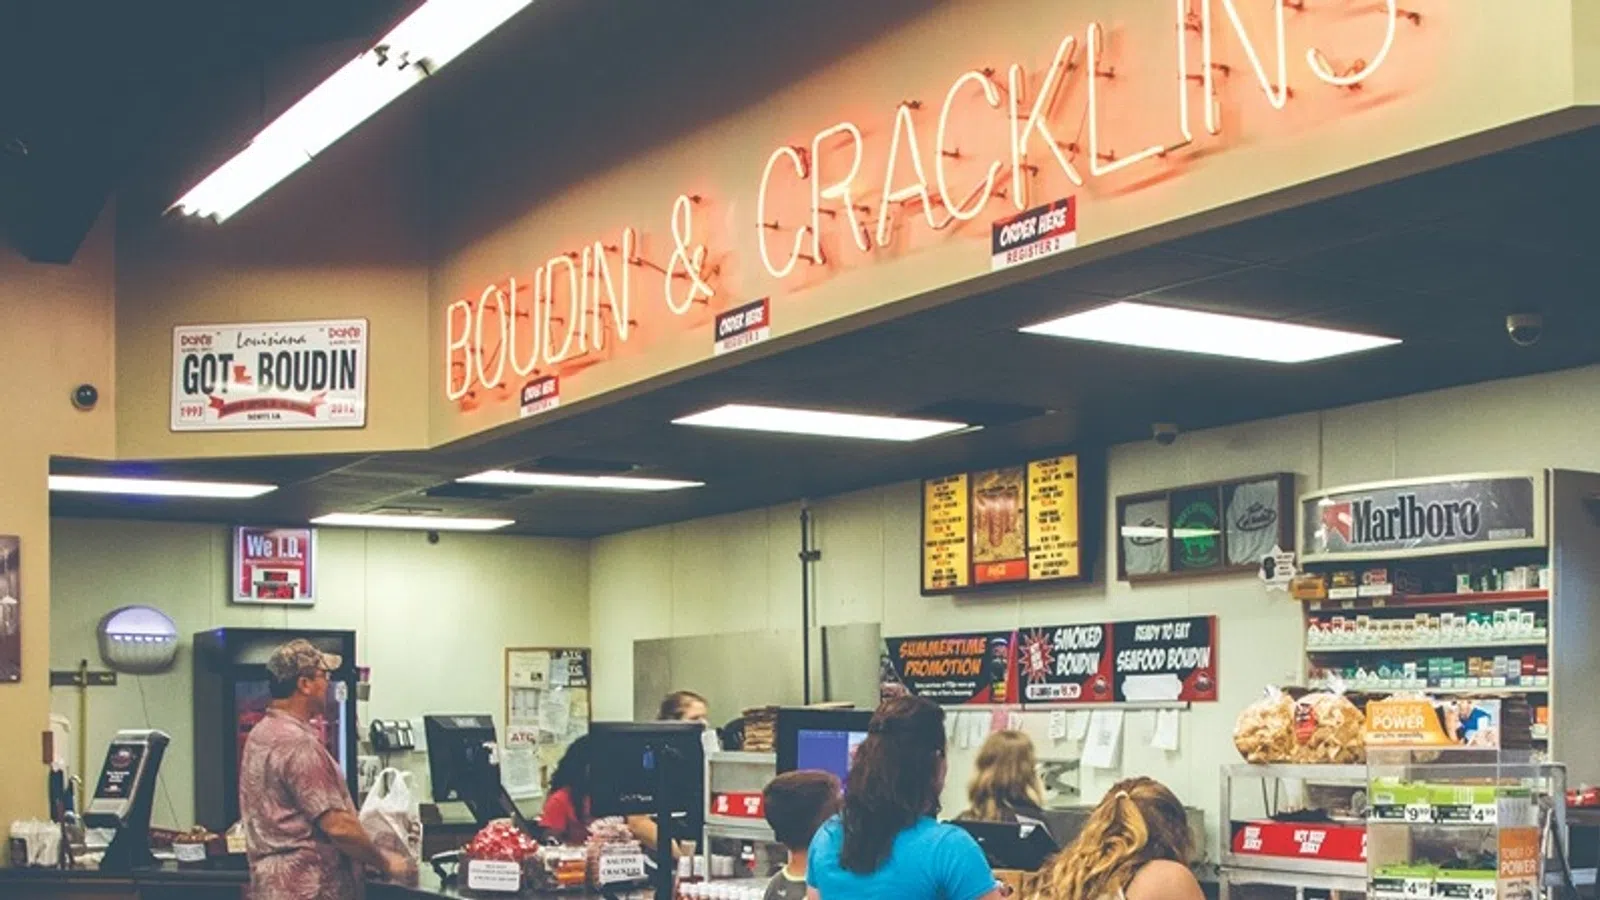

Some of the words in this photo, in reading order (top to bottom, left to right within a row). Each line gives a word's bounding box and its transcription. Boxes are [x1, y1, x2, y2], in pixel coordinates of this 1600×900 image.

[1000, 217, 1039, 247] ORDER
[1038, 207, 1069, 235] HERE
[1006, 241, 1052, 264] REGISTER
[446, 227, 634, 401] BOUDIN
[665, 194, 715, 316] &
[236, 331, 308, 349] Louisiana
[183, 353, 234, 395] GOT
[258, 349, 357, 392] BOUDIN
[1351, 495, 1479, 544] Marlboro
[247, 535, 273, 558] We
[278, 536, 304, 558] I.D.
[1053, 626, 1102, 651] SMOKED
[1134, 625, 1159, 641] READY
[1159, 624, 1172, 640] TO
[1171, 623, 1191, 639] EAT
[899, 637, 988, 659] SUMMERTIME
[1116, 649, 1167, 672] SEAFOOD
[1166, 647, 1211, 671] BOUDIN
[904, 658, 983, 677] PROMOTION
[1056, 652, 1100, 676] BOUDIN
[1371, 715, 1426, 731] POWER
[1501, 860, 1537, 875] POWER
